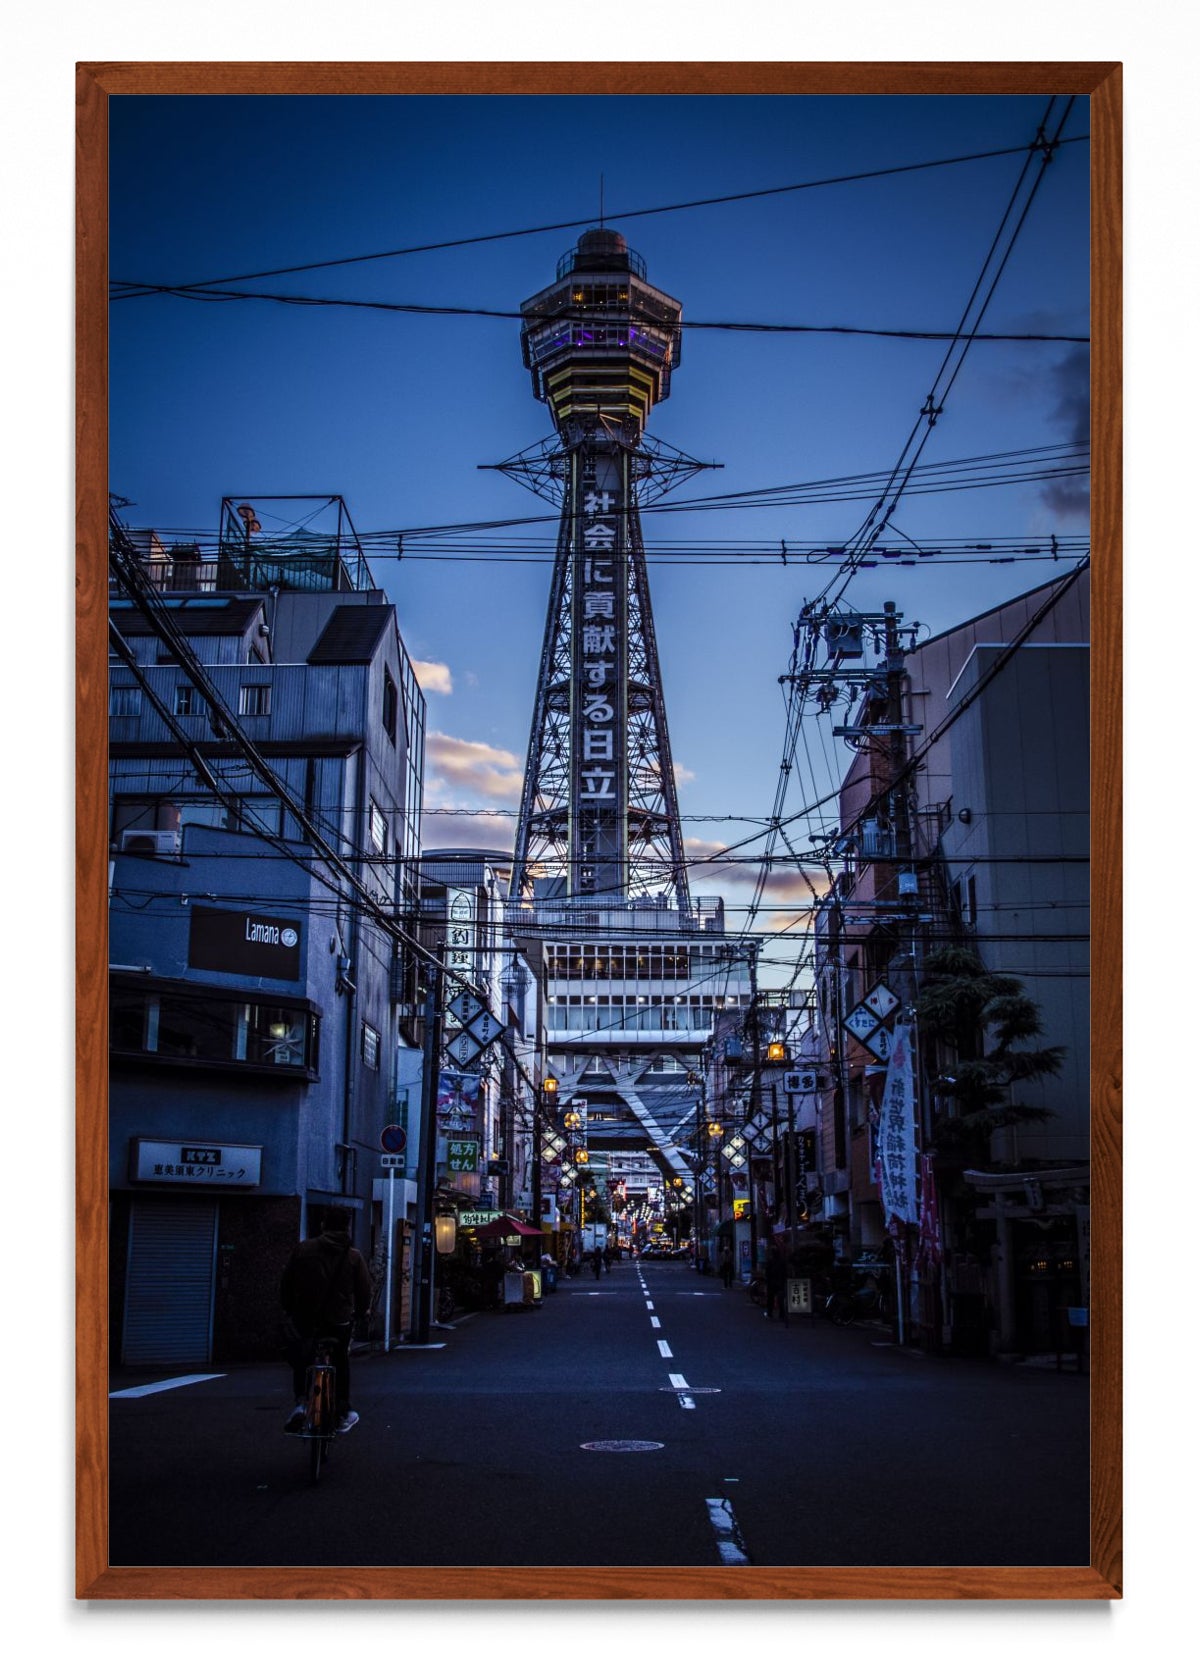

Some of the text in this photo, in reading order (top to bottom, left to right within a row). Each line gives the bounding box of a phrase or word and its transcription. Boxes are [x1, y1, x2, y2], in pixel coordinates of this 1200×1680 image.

[580, 491, 617, 800] 社会に貢献する日立
[245, 917, 280, 945] Lamana
[787, 1075, 814, 1089] 博多
[449, 1142, 476, 1155] 処方
[449, 1158, 475, 1171] せん
